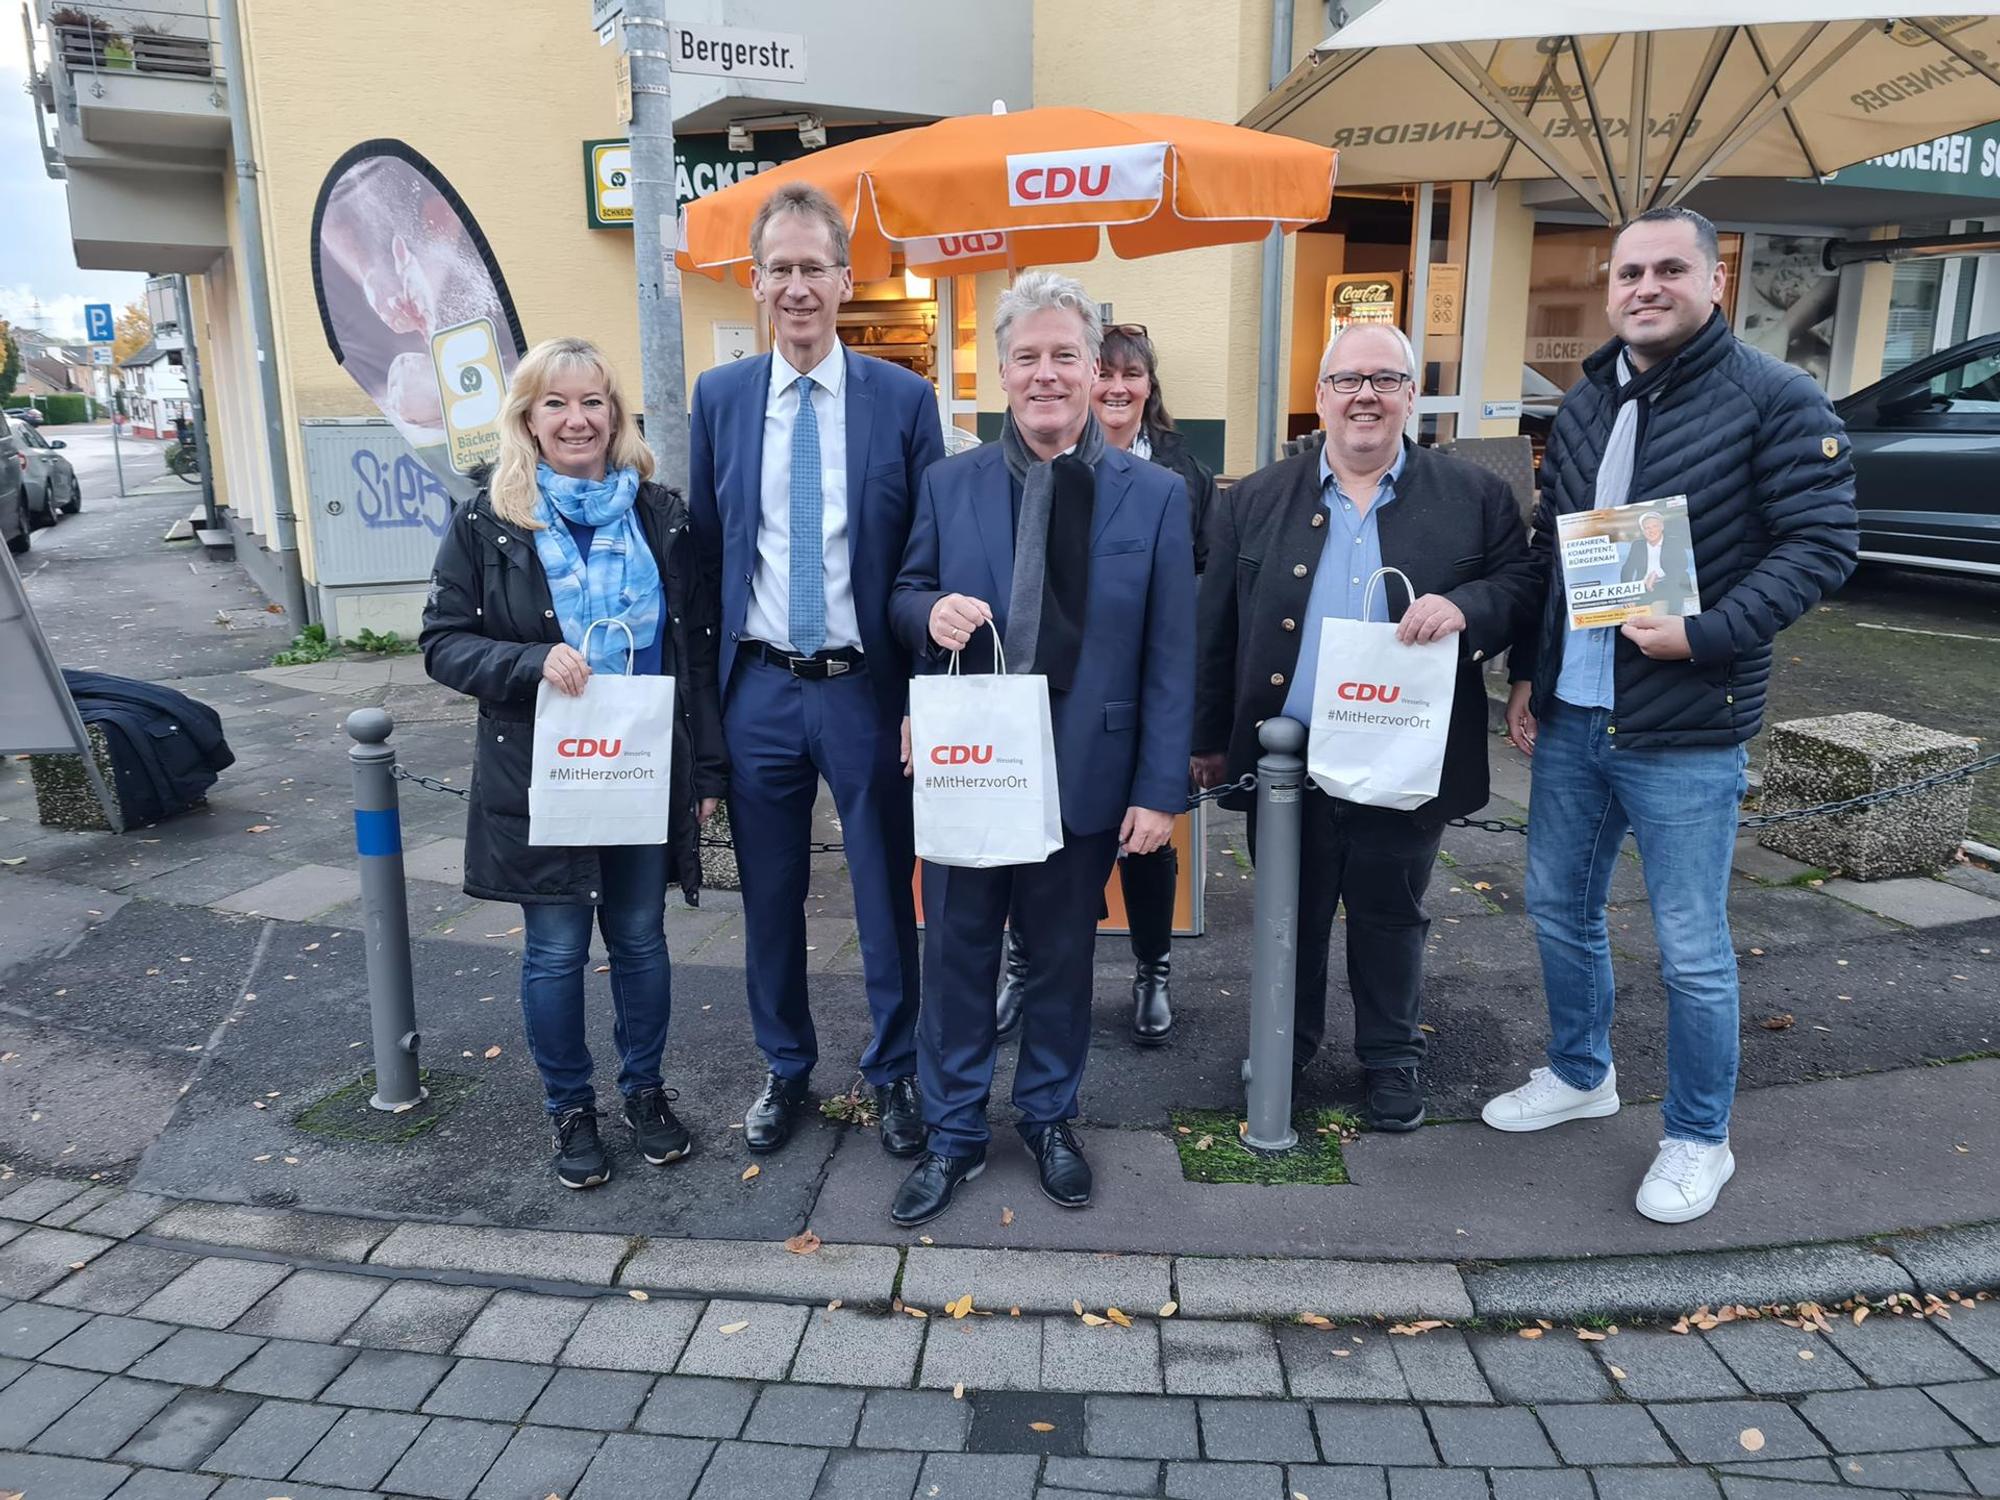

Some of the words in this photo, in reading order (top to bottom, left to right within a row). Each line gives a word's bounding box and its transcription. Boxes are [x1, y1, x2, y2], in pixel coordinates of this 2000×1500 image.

[681, 30, 794, 71] Bergerstr.
[1981, 138, 2000, 177] S
[1015, 165, 1111, 200] CDU
[1567, 538, 1607, 549] ERFAHREN,
[1568, 545, 1614, 557] KOMPETENT,
[1569, 554, 1616, 566] BÜRGERNAH
[1574, 588, 1605, 600] OLAF
[1607, 583, 1642, 597] KRAH
[1337, 682, 1401, 703] CDU
[1328, 709, 1431, 730] #MitHerzvorOrt
[557, 738, 622, 758] CDU
[930, 744, 993, 765] CDU
[549, 767, 655, 781] #MitHerzvorOrt
[925, 775, 1028, 789] #MitHerzvorOrt
